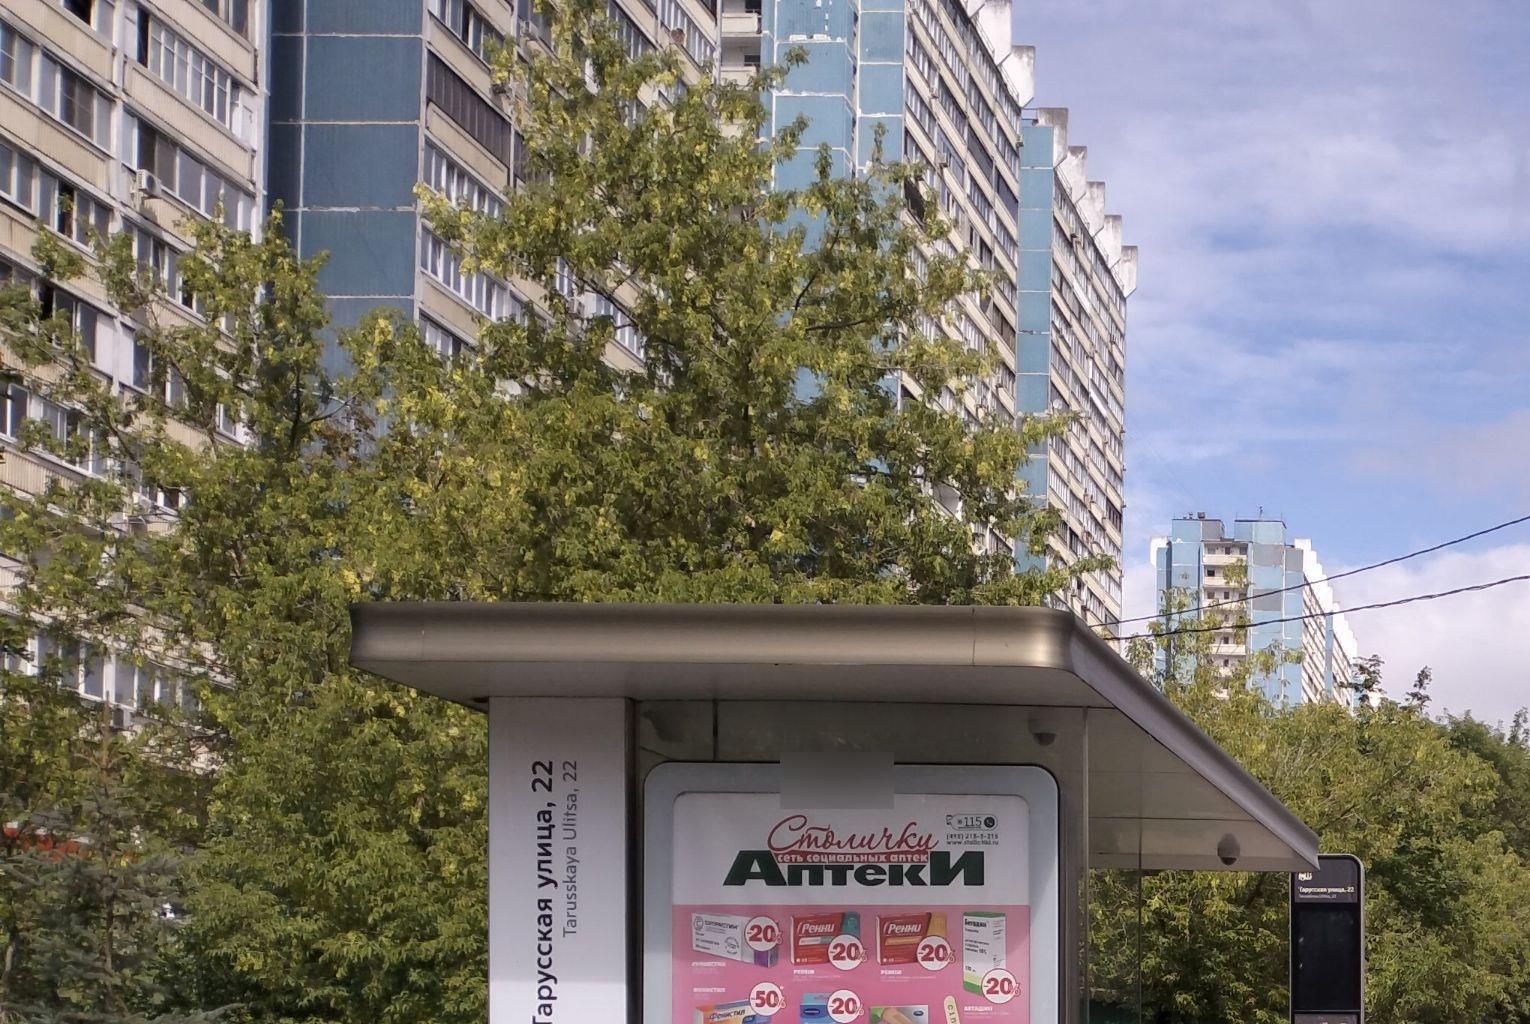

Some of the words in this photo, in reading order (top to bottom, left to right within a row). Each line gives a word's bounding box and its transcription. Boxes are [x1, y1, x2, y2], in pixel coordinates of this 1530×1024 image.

[531, 760, 553, 793] 22
[562, 760, 577, 781] 22
[562, 788, 580, 840] Ulitsa,
[767, 814, 939, 851] Столички
[536, 801, 557, 889] улица,
[777, 853, 803, 863] сеть
[806, 853, 887, 864] социальных
[889, 853, 929, 863] аптек
[562, 846, 580, 938] Tarusskaya
